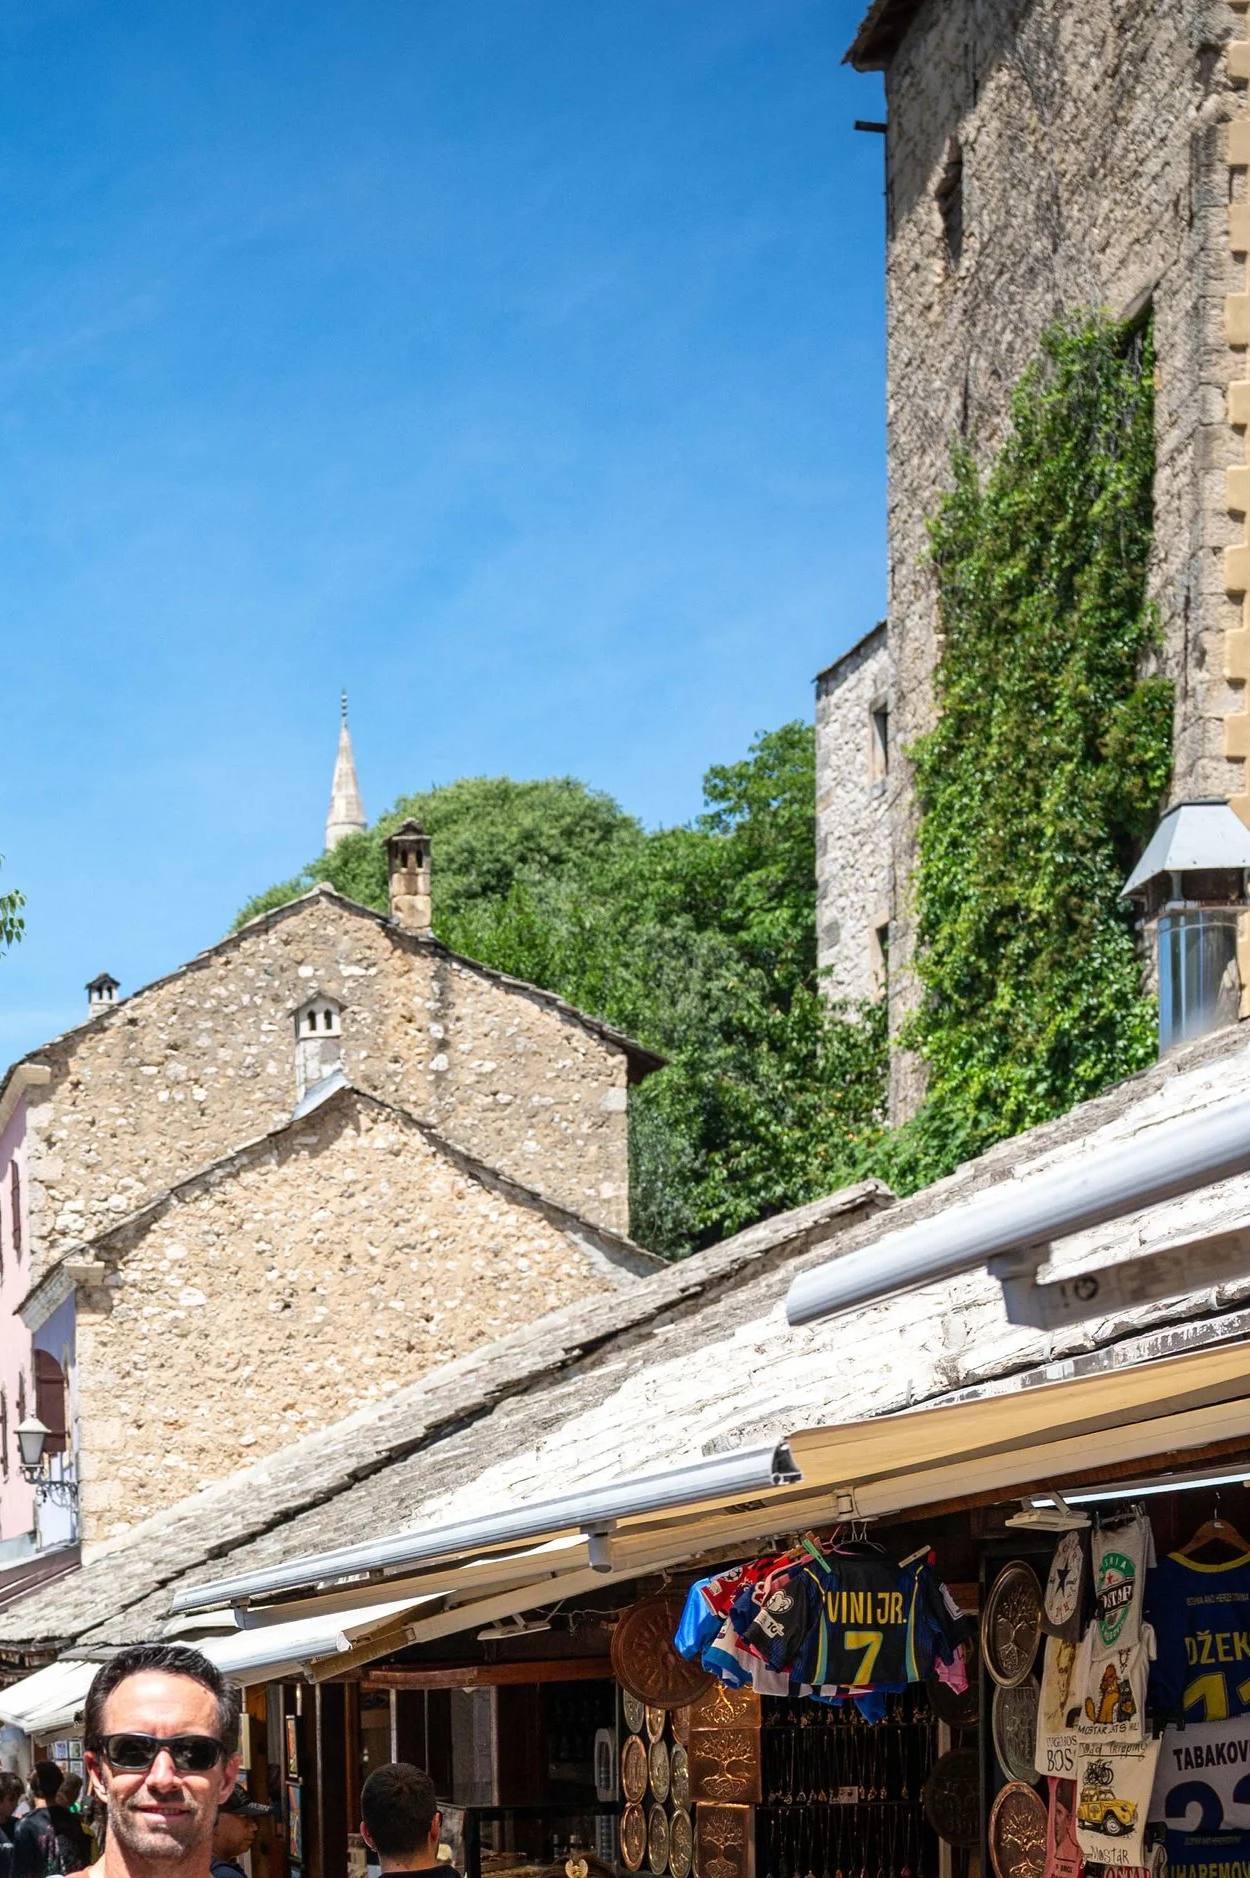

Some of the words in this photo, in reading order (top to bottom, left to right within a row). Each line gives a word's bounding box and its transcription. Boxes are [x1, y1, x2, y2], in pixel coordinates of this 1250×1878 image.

[827, 1591, 872, 1625] VINI
[876, 1591, 907, 1625] JR.
[844, 1630, 884, 1686] 7
[1047, 1748, 1076, 1772] BOS
[1173, 1739, 1250, 1771] TABAKOV
